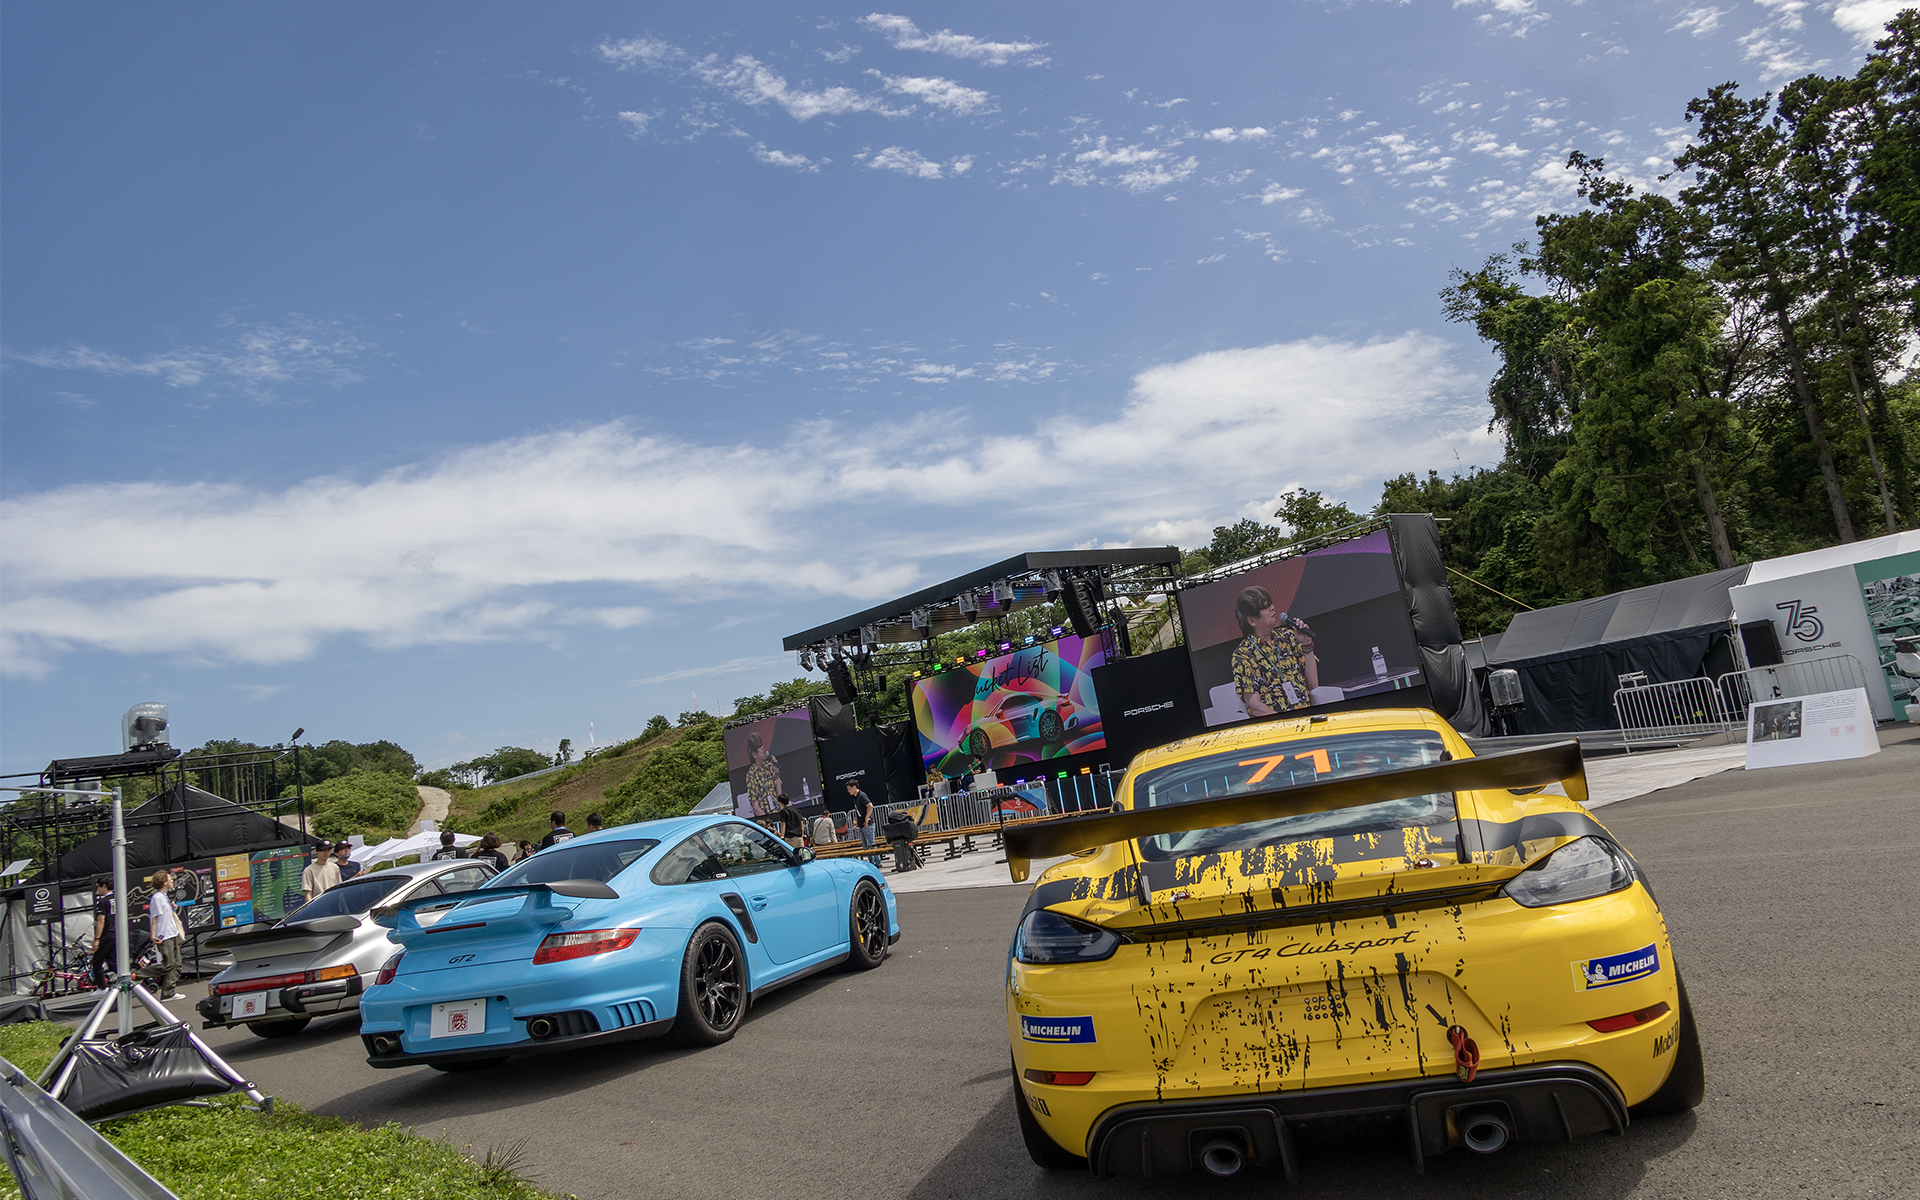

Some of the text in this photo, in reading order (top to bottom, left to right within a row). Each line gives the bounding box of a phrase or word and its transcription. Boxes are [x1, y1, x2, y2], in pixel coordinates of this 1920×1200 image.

[1775, 598, 1825, 643] 75
[975, 646, 1049, 695] ucket List
[1123, 700, 1174, 717] PORSCHE
[835, 769, 866, 781] PORSCHE
[1237, 748, 1332, 785] 71
[448, 953, 477, 964] GT2
[1209, 930, 1420, 965] GT4 Clubsport
[1608, 954, 1655, 977] MICHELIN
[1029, 1025, 1082, 1036] MICHELIN
